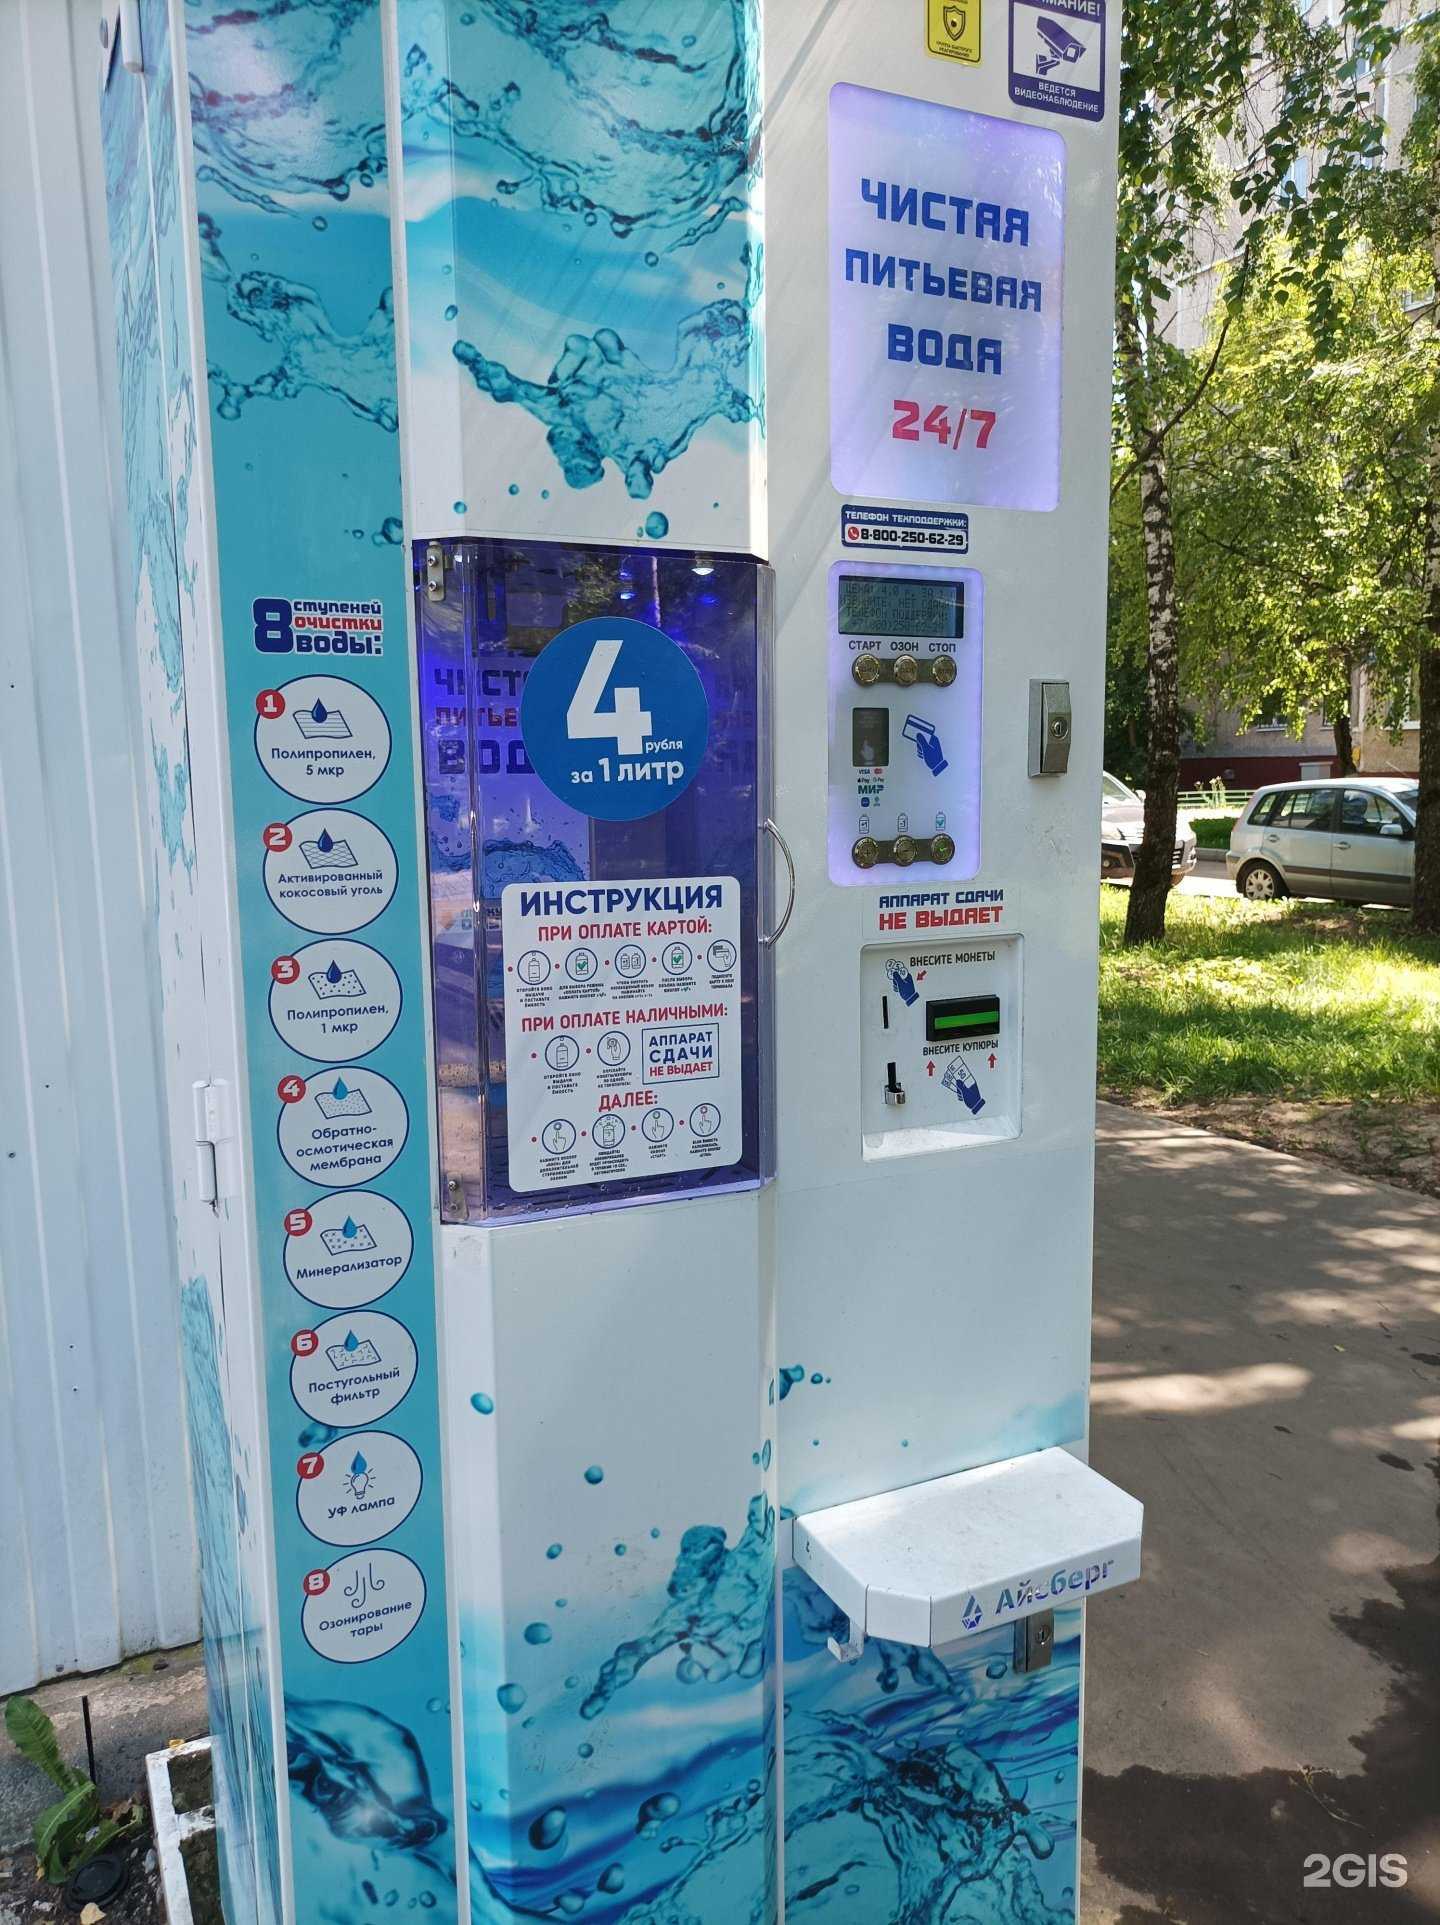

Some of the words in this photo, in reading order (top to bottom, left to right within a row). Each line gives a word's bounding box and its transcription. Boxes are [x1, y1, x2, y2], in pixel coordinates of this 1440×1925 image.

[1038, 82, 1076, 97] ВЕДЕТСЯ
[1014, 87, 1099, 113] ВИДЕОНАБЛЮДЕНИЕ
[861, 178, 1030, 246] ЧИСТАЯ
[845, 248, 1042, 312] ПИТЬЕВАЯ
[887, 323, 1002, 375] ВОДА
[892, 400, 997, 450] 24/7
[845, 511, 889, 521] ТЕЛЕФОН
[892, 514, 967, 528] ТЕХПОДДЕРЖКИ:
[294, 600, 382, 615] ступеней
[253, 598, 294, 653] 8
[294, 616, 382, 630] очистки
[296, 631, 382, 655] воды:
[848, 640, 882, 651] СТАРТ
[890, 642, 919, 652] ОЗОН
[929, 643, 957, 653] СТОП
[264, 694, 278, 713] 1
[566, 639, 653, 756] 4
[271, 747, 376, 761] Полипропилен,
[646, 738, 684, 754] рубля
[305, 765, 313, 776] 5
[317, 767, 345, 777] мкр
[571, 769, 593, 784] за
[598, 758, 610, 782] 1
[617, 759, 684, 786] литр
[858, 785, 885, 795] МИР
[269, 827, 286, 846] 2
[278, 868, 383, 885] Активированный
[279, 886, 348, 898] кокосовый
[350, 886, 383, 898] уголь
[520, 884, 723, 917] ИНСТРУКЦИЯ
[879, 892, 950, 908] АППАРАТ
[955, 889, 1004, 904] СДАЧИ
[538, 925, 572, 941] ПРИ
[578, 921, 642, 940] ОПЛАТЕ
[647, 915, 713, 936] КАРТОЙ:
[879, 911, 907, 931] НЕ
[915, 906, 1004, 929] ВЫДАЕТ
[909, 954, 953, 967] ВНЕСИТЕ
[955, 951, 996, 963] МОНЕТЫ
[277, 960, 294, 979] 3
[287, 1003, 389, 1021] Полипропилен,
[521, 1016, 554, 1032] ПРИ
[560, 1011, 621, 1030] ОПЛАТЕ
[625, 1003, 728, 1024] НАЛИЧНЫМИ:
[321, 1023, 326, 1034] 1
[332, 1022, 358, 1034] мкр
[649, 1031, 713, 1047] АППАРАТ
[922, 1043, 961, 1056] ВНЕСИТЕ
[962, 1040, 999, 1053] КУПЮРЫ
[649, 1045, 713, 1065] СДАЧИ
[649, 1064, 664, 1077] НЕ
[666, 1061, 713, 1076] ВЫДАЕТ
[283, 1079, 300, 1097] 4
[598, 1090, 659, 1113] ДАЛЕЕ:
[311, 1125, 377, 1141] Обратно-
[296, 1137, 394, 1158] осмотическая
[310, 1154, 382, 1172] мембрана
[289, 1212, 306, 1231] 5
[296, 1254, 402, 1280] Минерализатор
[296, 1333, 314, 1352] 6
[308, 1366, 401, 1393] Постугольный
[330, 1386, 381, 1406] фильтр
[303, 1457, 319, 1475] 7
[351, 1495, 396, 1514] лампа
[307, 1572, 325, 1591] 8
[995, 1559, 1115, 1615] Айсберг
[319, 1600, 413, 1632] Озонирование
[350, 1622, 384, 1639] тары
